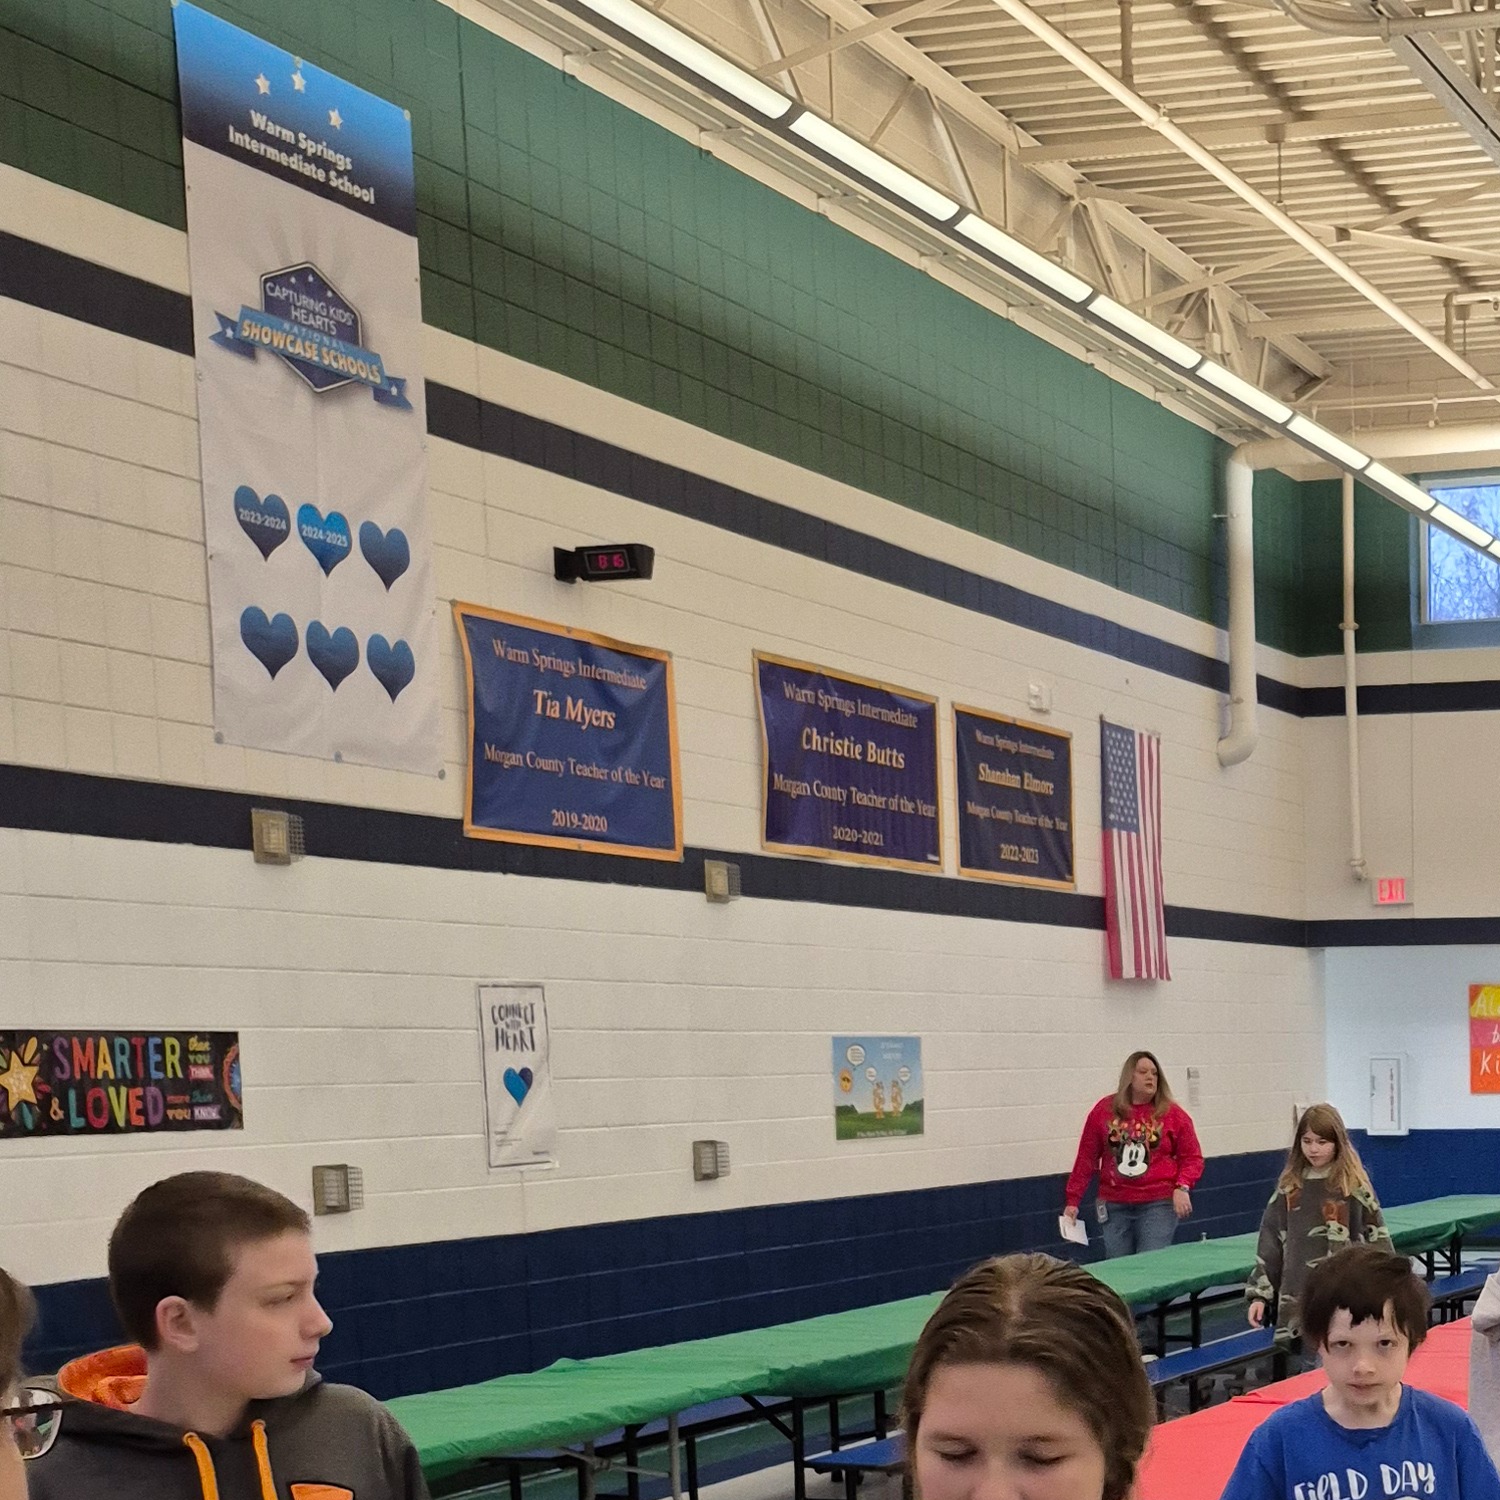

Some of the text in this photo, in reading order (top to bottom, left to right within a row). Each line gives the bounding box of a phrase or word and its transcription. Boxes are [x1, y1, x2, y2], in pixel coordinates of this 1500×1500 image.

[250, 110, 352, 171] Warm Springs
[229, 125, 375, 204] Intermediate School
[266, 281, 327, 316] CAPTURING
[291, 305, 337, 335] HEARTS
[242, 320, 381, 384] SHOWCASE SCHOOLS
[239, 508, 287, 531] 2023-2024
[302, 524, 348, 548] 2024-2025
[492, 638, 647, 690] Warm Springs Intermediate
[533, 689, 616, 730] Tia Myers
[817, 689, 855, 717] Springs
[857, 699, 918, 729] Intermediate
[484, 742, 666, 789] Morgan County Teacher of the Year
[802, 727, 905, 769] Christie Butts
[773, 773, 811, 799] Morgan
[813, 780, 847, 806] County
[850, 787, 887, 809] Teacher
[901, 796, 915, 813] the
[917, 799, 936, 818] Year
[551, 809, 608, 832] 2019-2020
[832, 826, 884, 846] 2020-2021
[1378, 878, 1405, 901] EXIT
[53, 1036, 184, 1080] SMARTER
[495, 1026, 536, 1052] HEART
[50, 1086, 164, 1129] & LOVED
